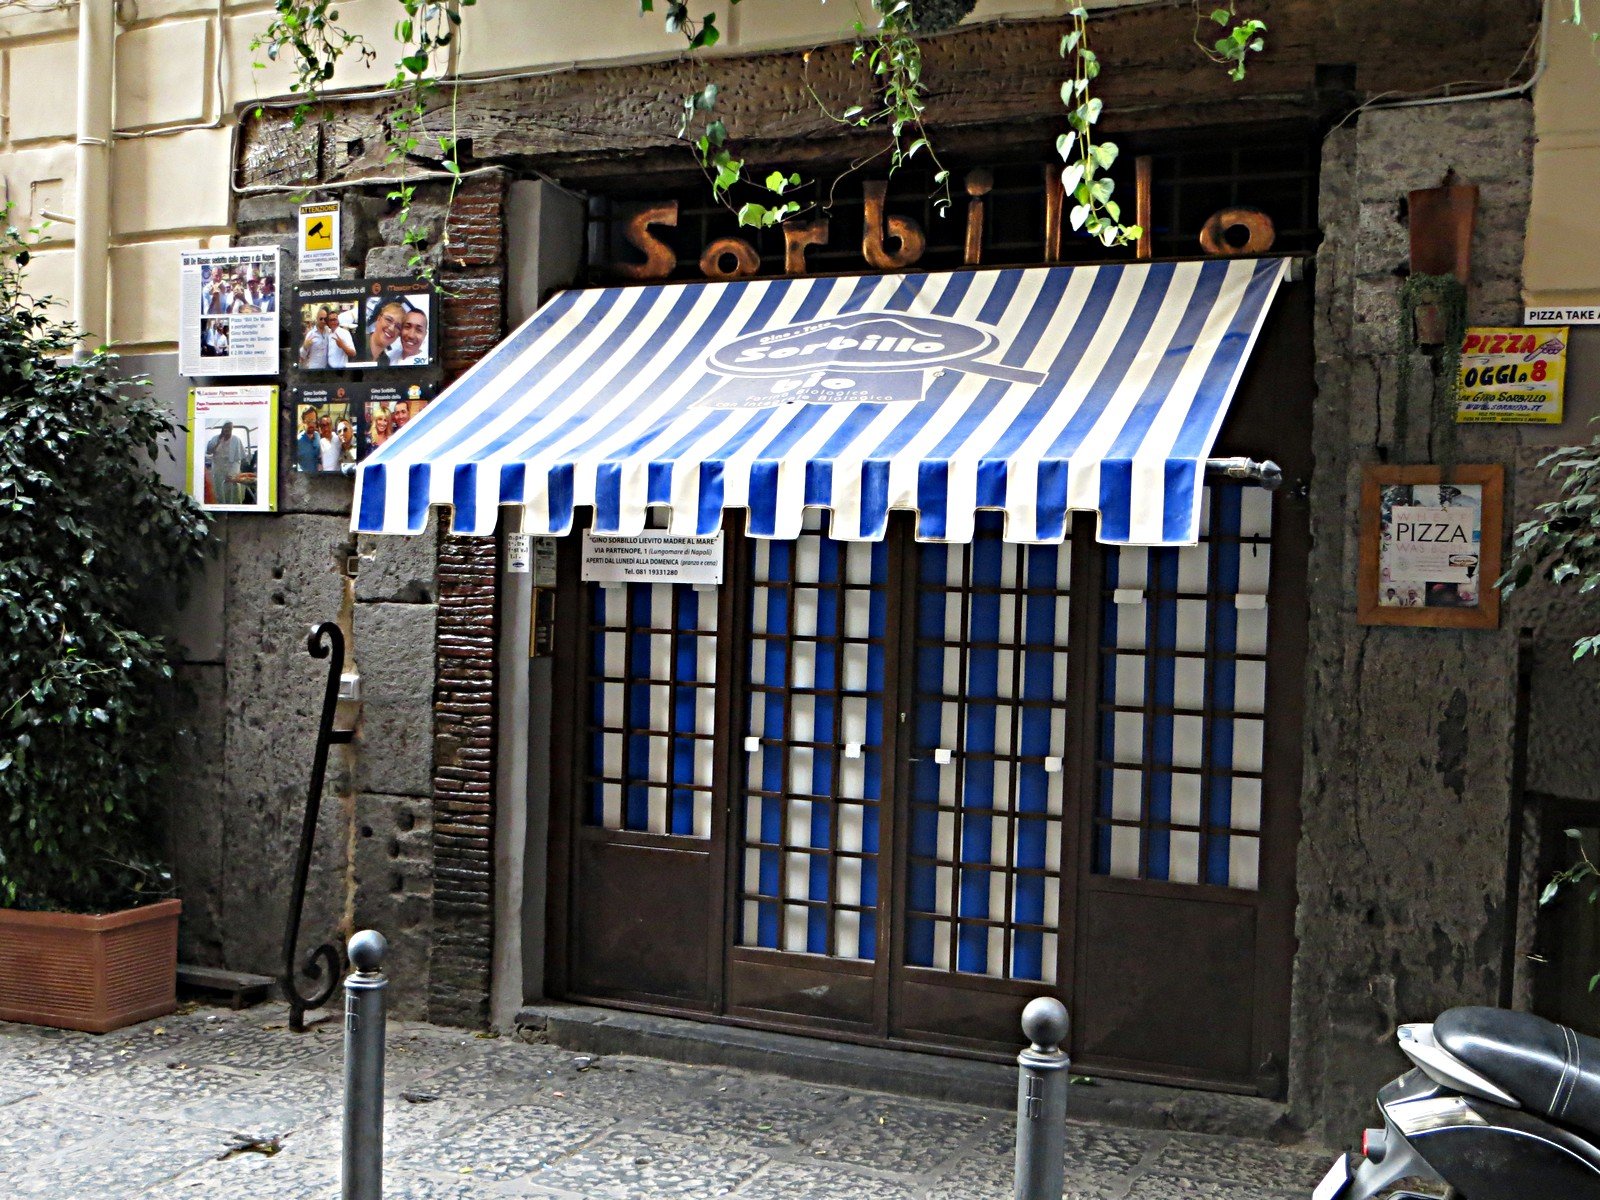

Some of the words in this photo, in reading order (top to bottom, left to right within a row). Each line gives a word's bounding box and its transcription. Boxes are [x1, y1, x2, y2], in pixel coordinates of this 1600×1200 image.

[619, 155, 1276, 279] Sorbillo
[312, 288, 332, 296] Sorbillo
[360, 286, 366, 294] di
[1529, 311, 1563, 320] PIZZA
[1566, 310, 1595, 320] TAKE
[734, 335, 946, 362] Sorbillo
[1461, 334, 1536, 354] PIZZA
[770, 372, 856, 394] bio
[1464, 364, 1518, 388] OGGI
[1530, 360, 1548, 382] 8
[1396, 522, 1468, 544] PIZZA
[648, 548, 683, 556] (Lungomare
